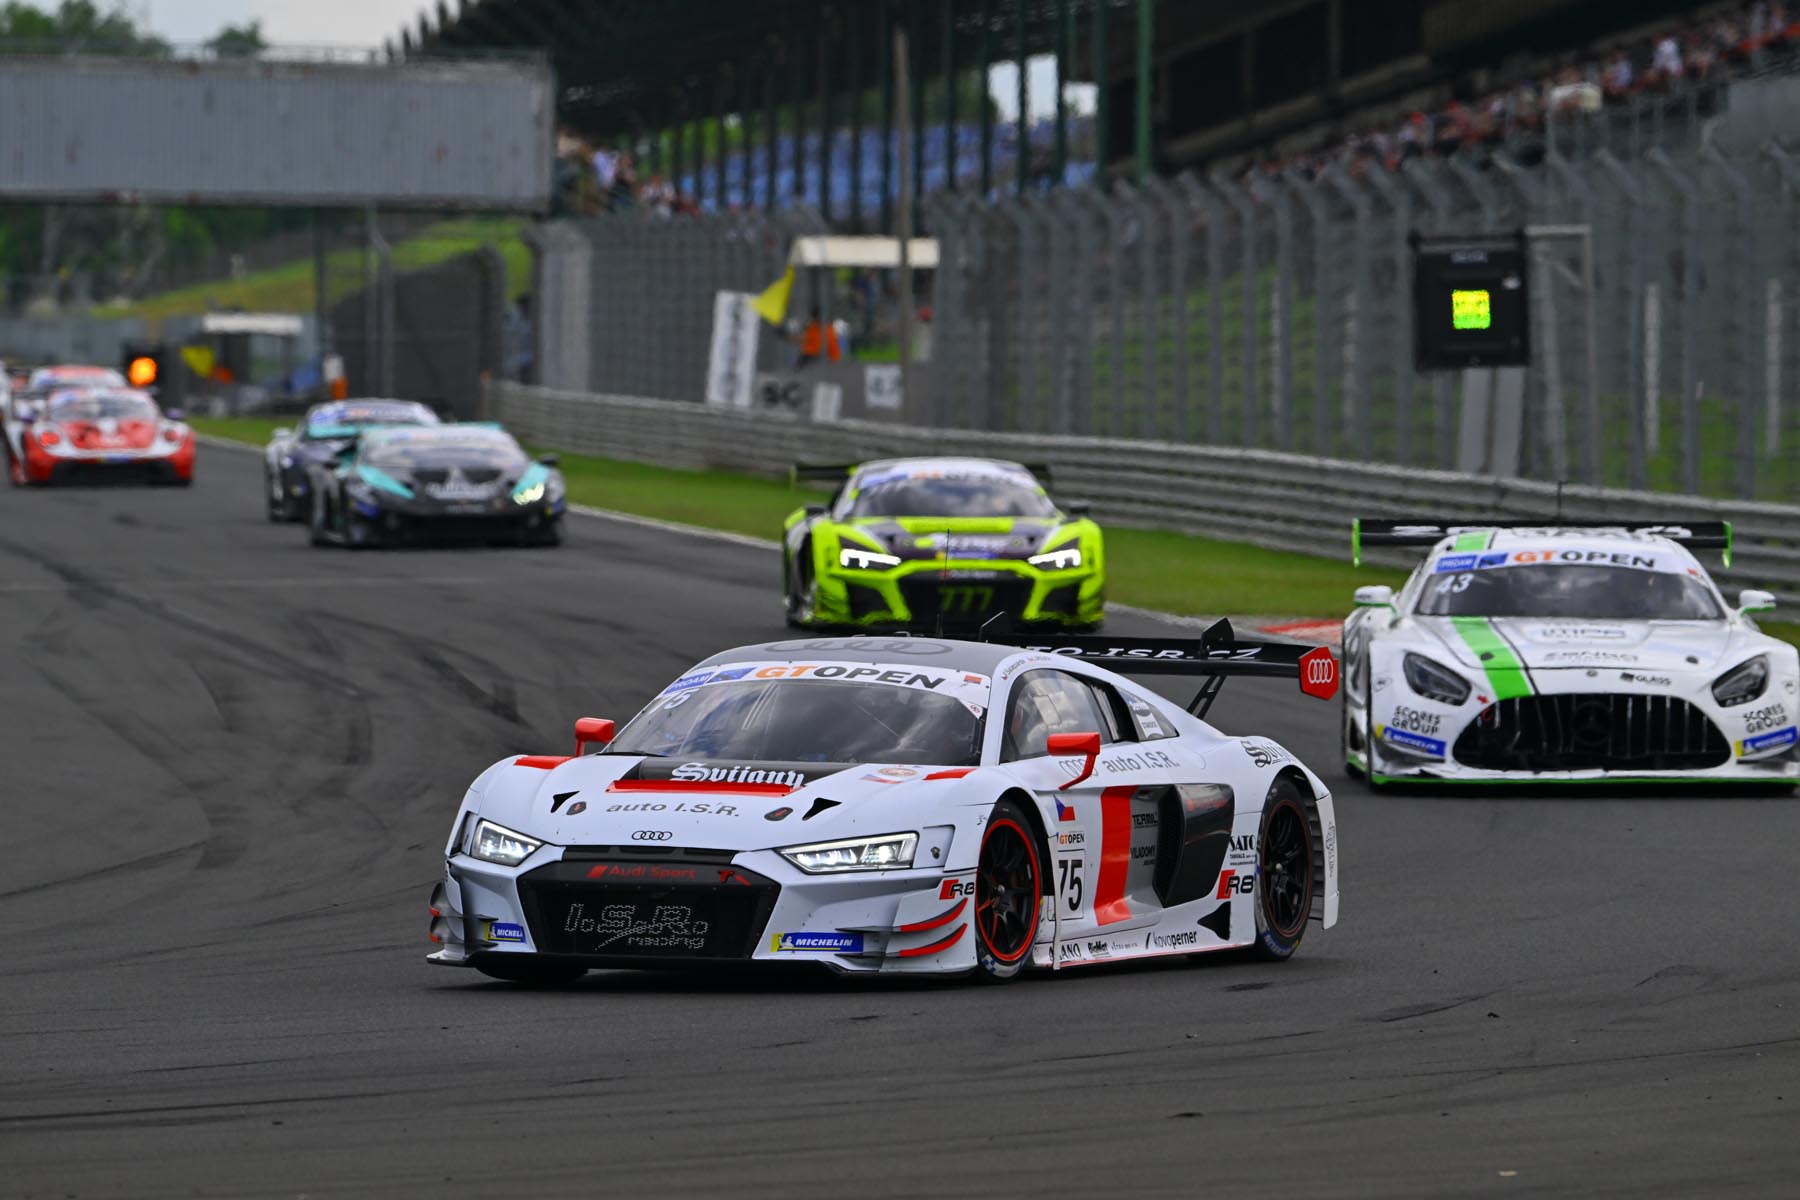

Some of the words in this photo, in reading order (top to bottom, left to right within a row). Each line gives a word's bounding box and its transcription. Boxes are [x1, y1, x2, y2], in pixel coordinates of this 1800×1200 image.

[1514, 550, 1656, 567] GTOPEN
[1436, 573, 1474, 593] 43
[755, 665, 946, 690] GTOPEN
[669, 762, 805, 790] Svijany
[606, 803, 667, 813] auto
[674, 803, 739, 817] I.S.R.
[1059, 833, 1085, 845] GTOPEN
[609, 865, 646, 877] Audi
[949, 882, 975, 896] R8
[1058, 859, 1083, 911] 75
[1225, 874, 1254, 895] R8
[795, 938, 853, 946] MICHELIN
